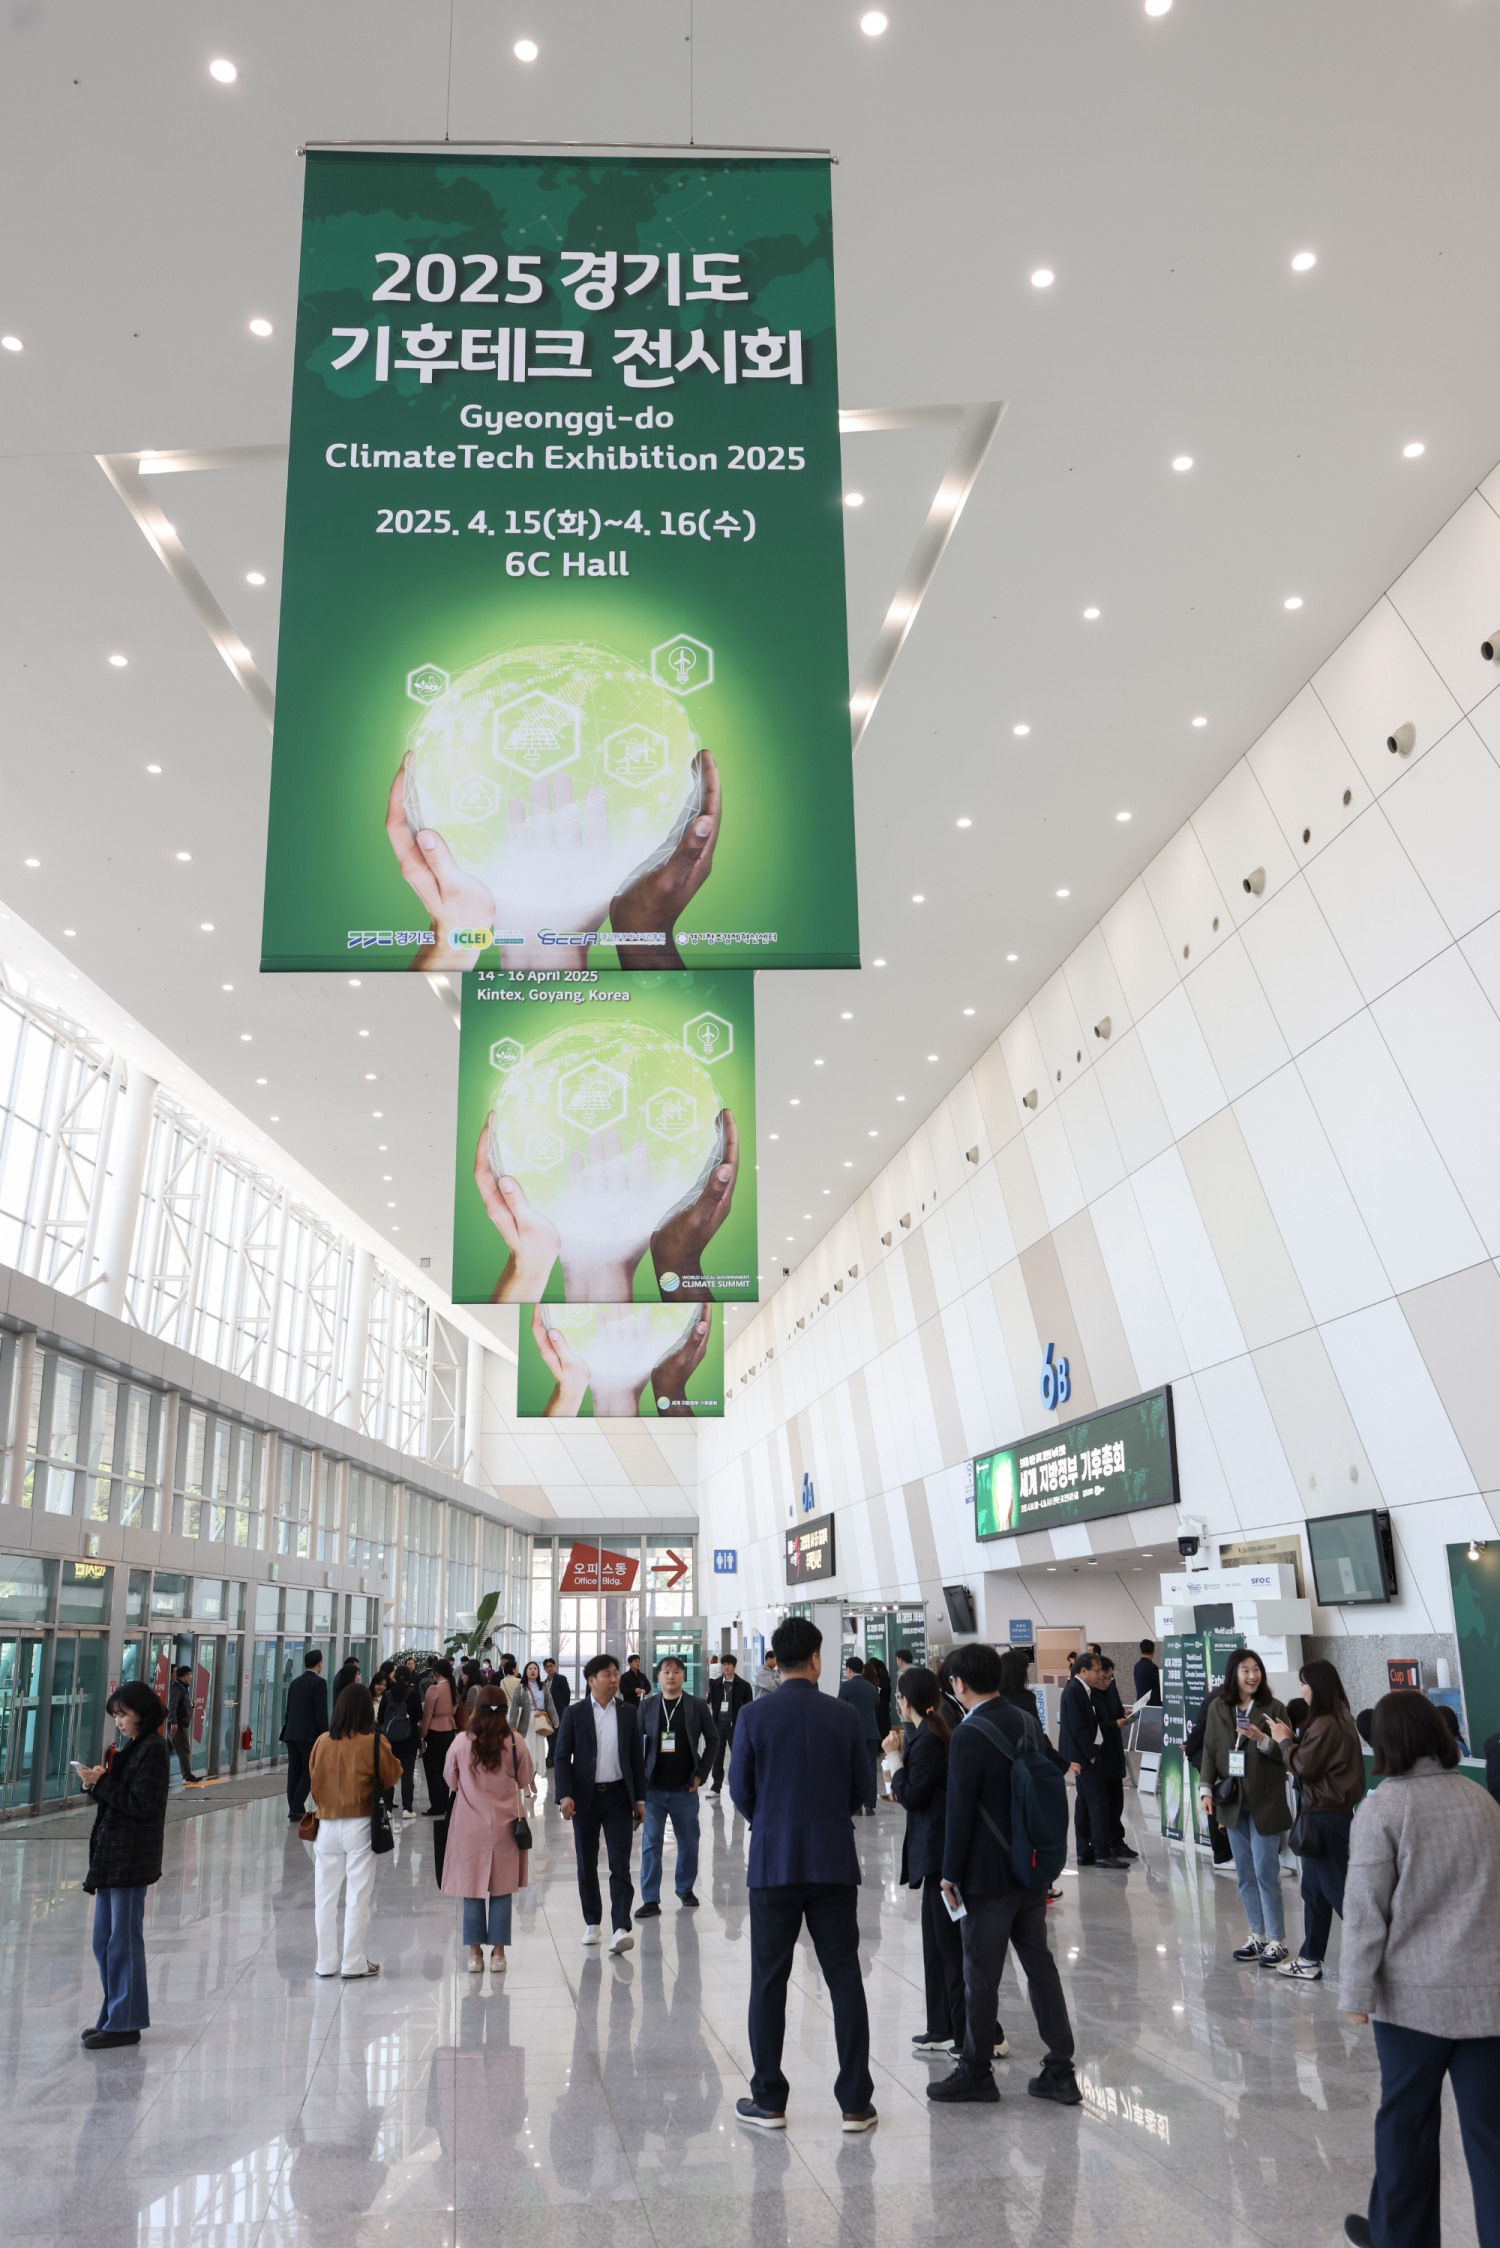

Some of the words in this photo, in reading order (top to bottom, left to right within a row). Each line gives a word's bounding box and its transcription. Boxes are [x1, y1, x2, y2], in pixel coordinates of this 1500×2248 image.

[372, 252, 543, 304] 2025
[560, 251, 749, 310] 경기도
[330, 322, 592, 384] 기후테크
[612, 326, 803, 389] 전시회
[460, 404, 674, 436] Gyeonggi-do
[325, 443, 534, 470] ClimateTech
[544, 445, 718, 471] Exhibition
[726, 446, 806, 471] 2025
[376, 510, 459, 536] 2025.
[467, 509, 495, 536] 4.
[660, 510, 757, 542] 16(수)
[505, 551, 551, 577] 6C
[562, 550, 629, 577] Hall
[395, 931, 435, 945] 경기도
[454, 933, 486, 944] ICLEI
[690, 932, 777, 944] 경기창조경제혁신센터
[478, 971, 495, 981] 14
[508, 971, 525, 981] 16
[527, 971, 560, 984] April
[564, 971, 598, 982] 2025
[477, 988, 525, 1001] Kintex,
[529, 989, 585, 1004] Goyang,
[589, 989, 630, 1001] Korea
[682, 1280, 716, 1288] CLIMATE
[718, 1280, 750, 1288] SUMMIT
[1041, 1343, 1071, 1411] 6B
[1020, 1467, 1037, 1497] 세계
[1039, 1454, 1078, 1492] 지방정부
[1080, 1440, 1125, 1481] 기후총회
[573, 1562, 627, 1576] 오피스동
[574, 1577, 598, 1585] Office
[602, 1577, 622, 1586] Bldg.
[1390, 1668, 1404, 1684] Cup
